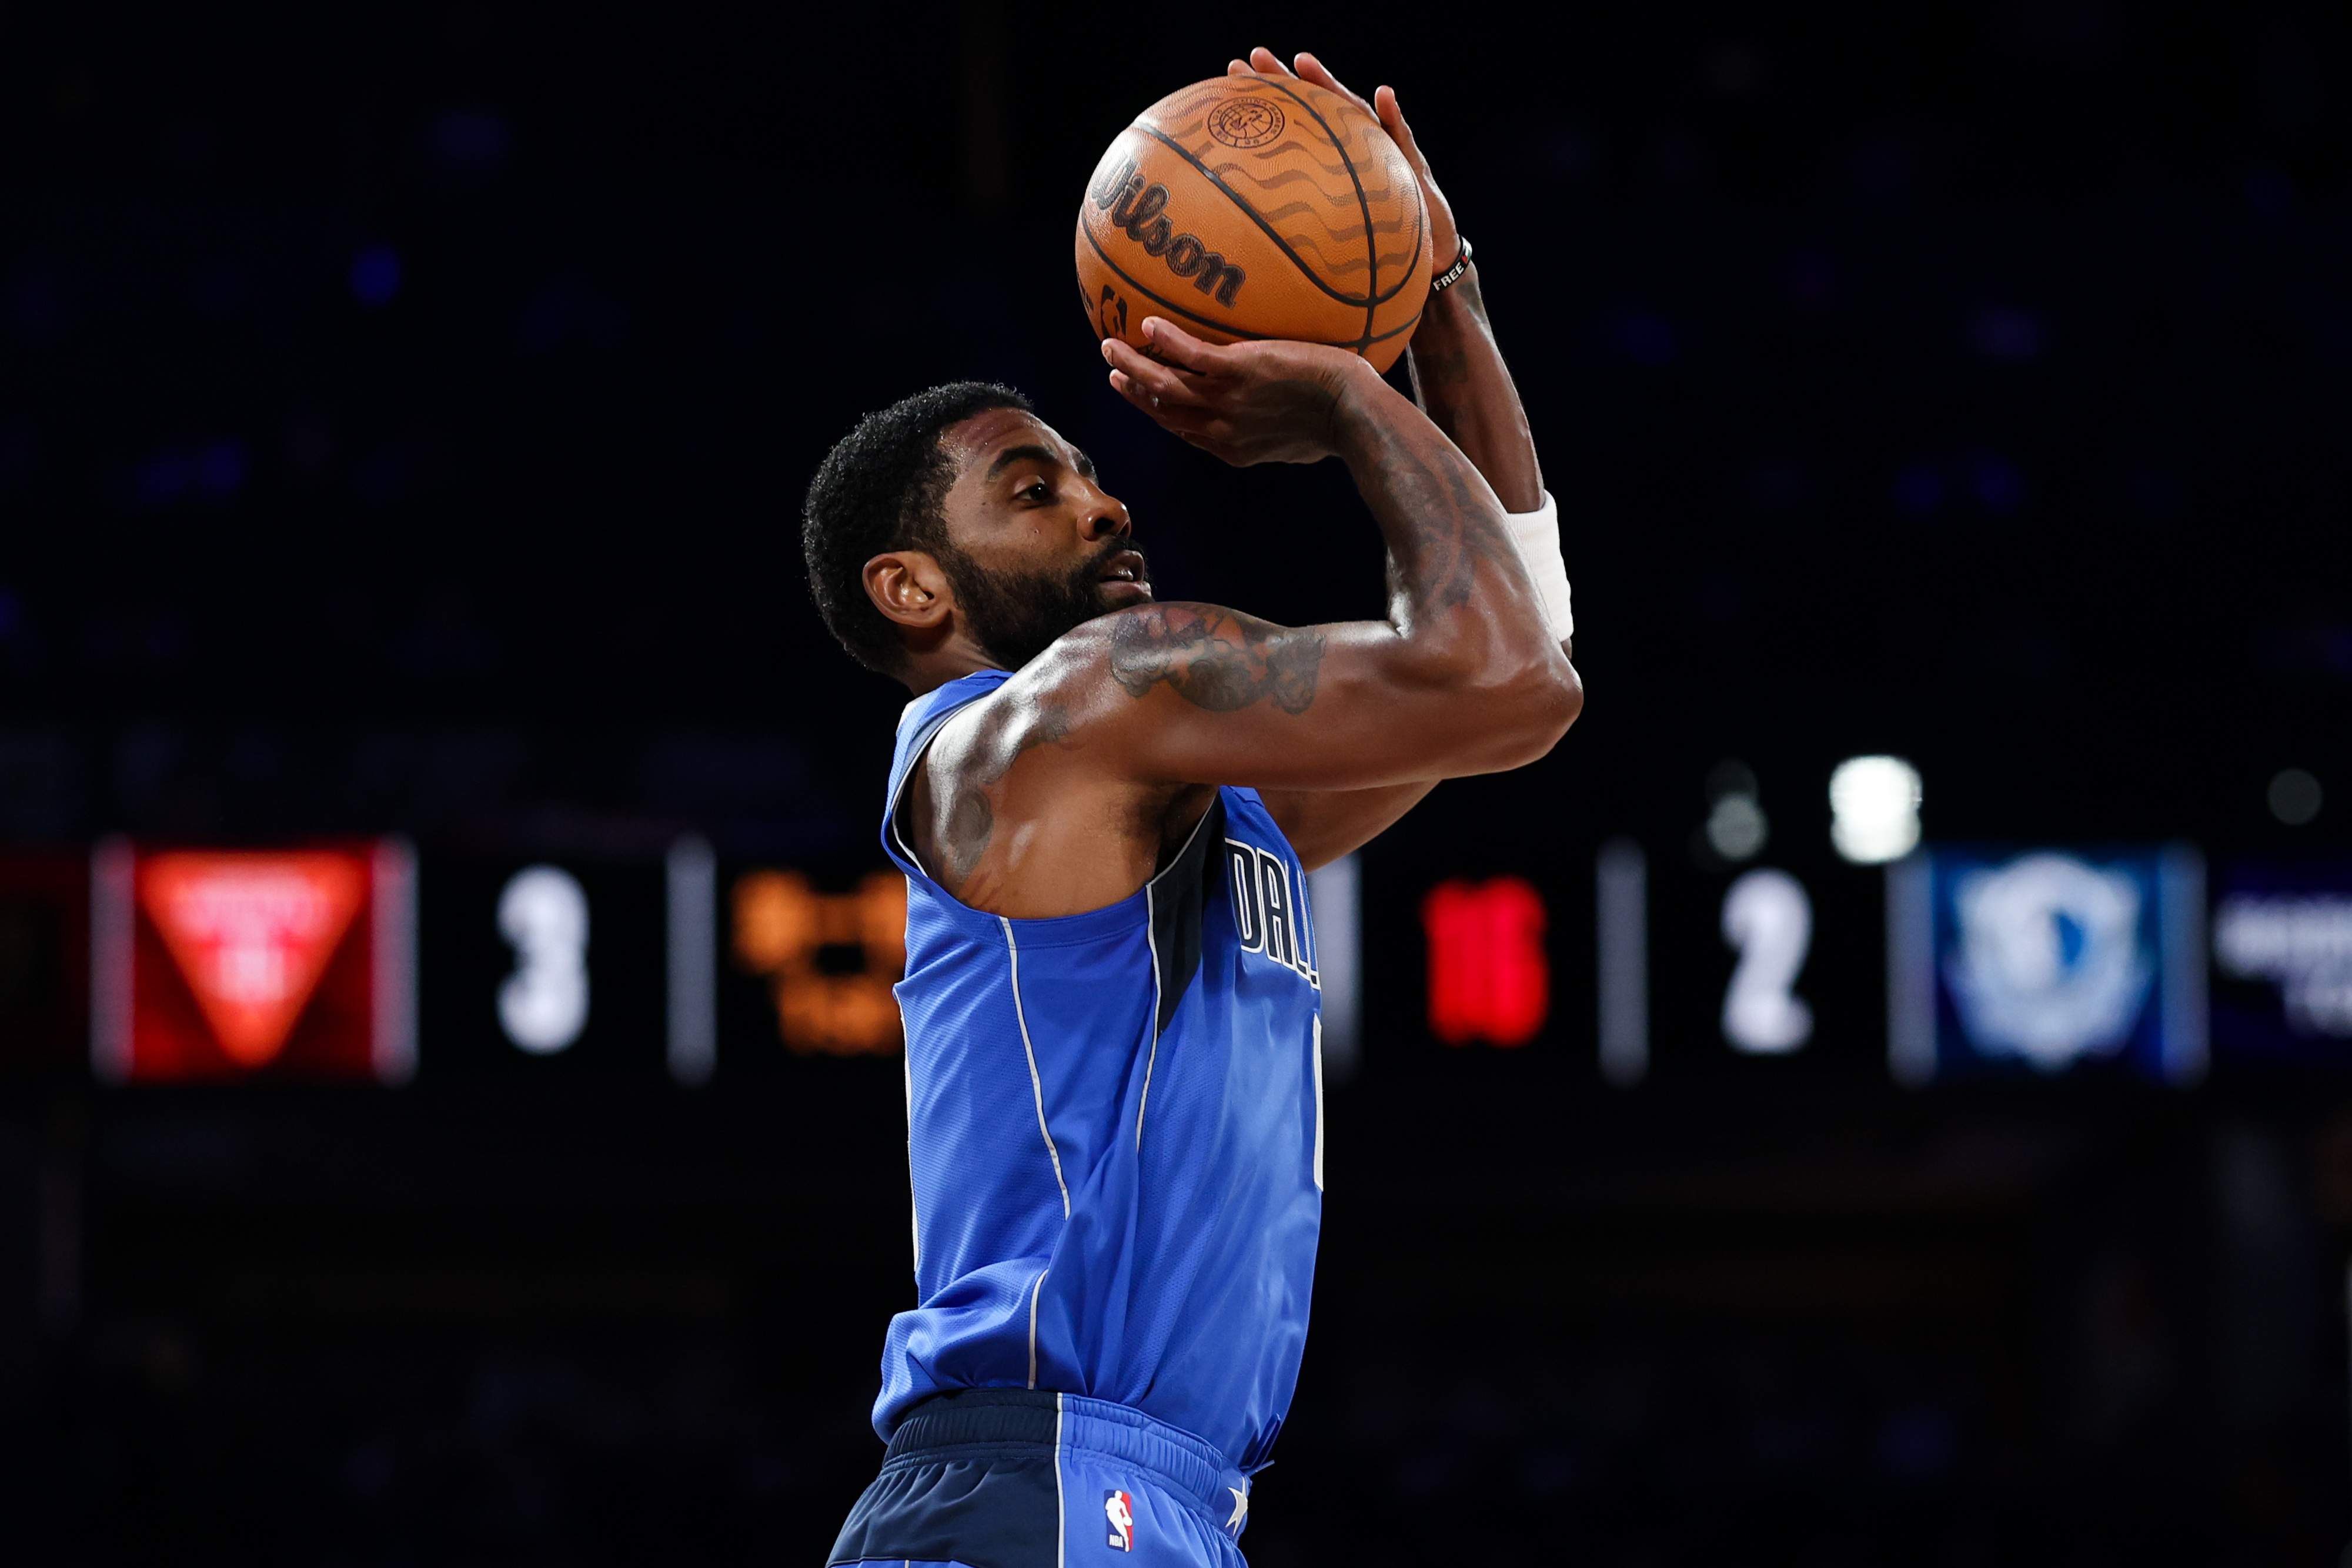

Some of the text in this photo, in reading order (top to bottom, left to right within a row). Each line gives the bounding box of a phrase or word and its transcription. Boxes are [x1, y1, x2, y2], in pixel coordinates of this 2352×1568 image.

[1091, 152, 1247, 310] Wilson
[1433, 262, 1465, 291] FREE
[496, 864, 590, 1055] 3
[1720, 867, 1814, 1054] 2
[1109, 1534, 1124, 1548] NBA
